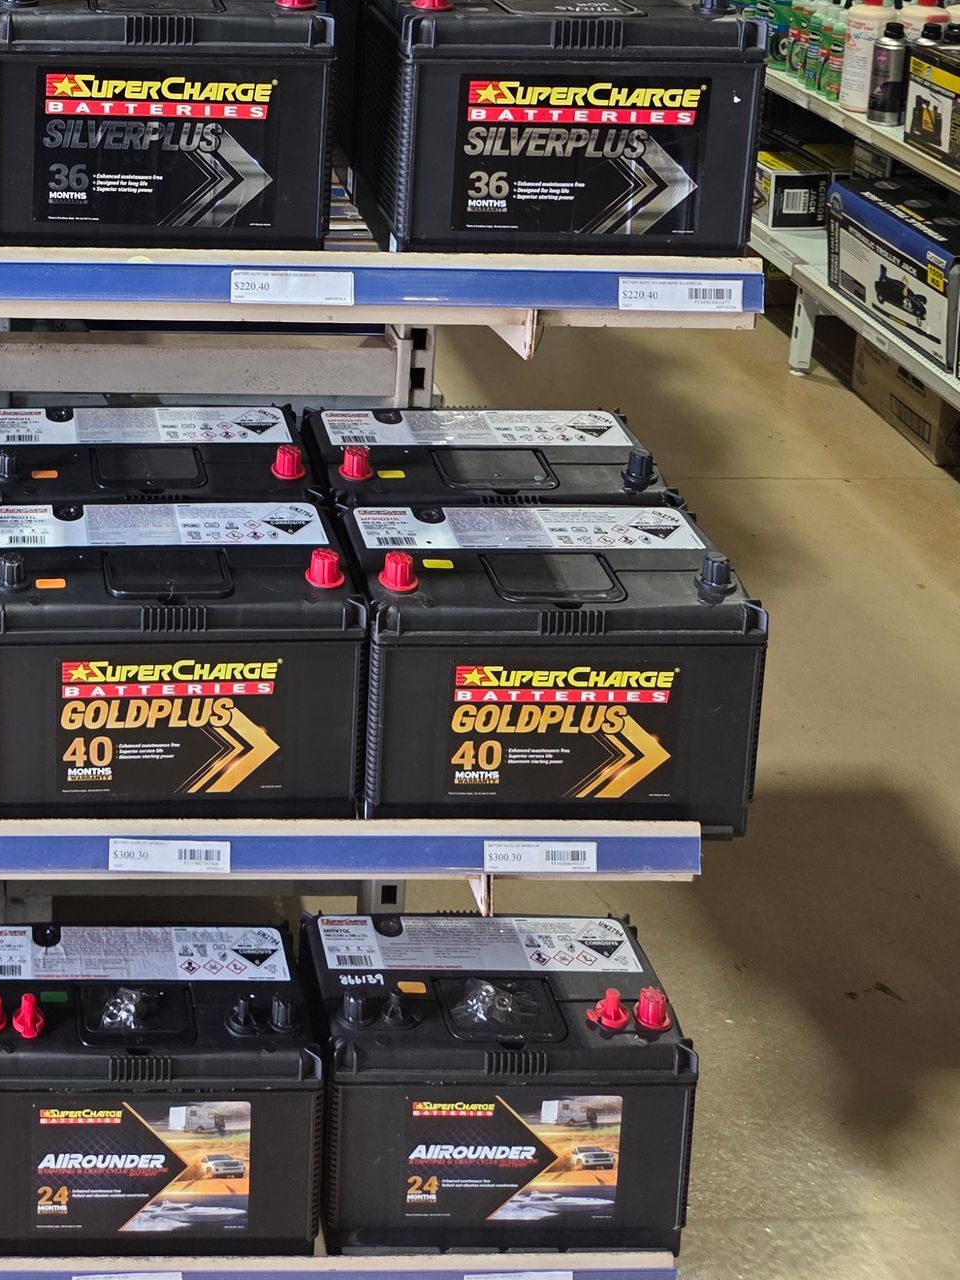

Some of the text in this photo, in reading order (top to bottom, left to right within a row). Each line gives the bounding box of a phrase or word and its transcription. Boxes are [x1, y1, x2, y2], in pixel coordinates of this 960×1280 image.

[73, 75, 272, 102] SUPERCHARGE
[498, 82, 701, 107] SUPERCHARGE
[48, 102, 263, 117] BATTERIES
[470, 109, 692, 123] BATTERIES
[43, 120, 223, 151] SILVERPLUS
[464, 127, 648, 158] SILVERPLUS
[48, 163, 88, 191] 36
[468, 171, 509, 198] 36
[234, 281, 269, 291] $220.40
[623, 289, 658, 299] $220.40
[88, 660, 277, 681] SUPERCHARGE
[482, 667, 674, 687] SUPERCHARGE
[64, 683, 271, 696] BATTERIES
[457, 691, 666, 701] BATTERIES
[61, 698, 234, 729] GOLDPLUS
[451, 705, 627, 733] GOLDPLUS
[63, 736, 113, 767] 40
[451, 740, 502, 770] 40
[113, 850, 148, 859] $300.30
[488, 853, 521, 861] $300.30
[37, 1185, 68, 1204] 24
[407, 1176, 438, 1194] 24
